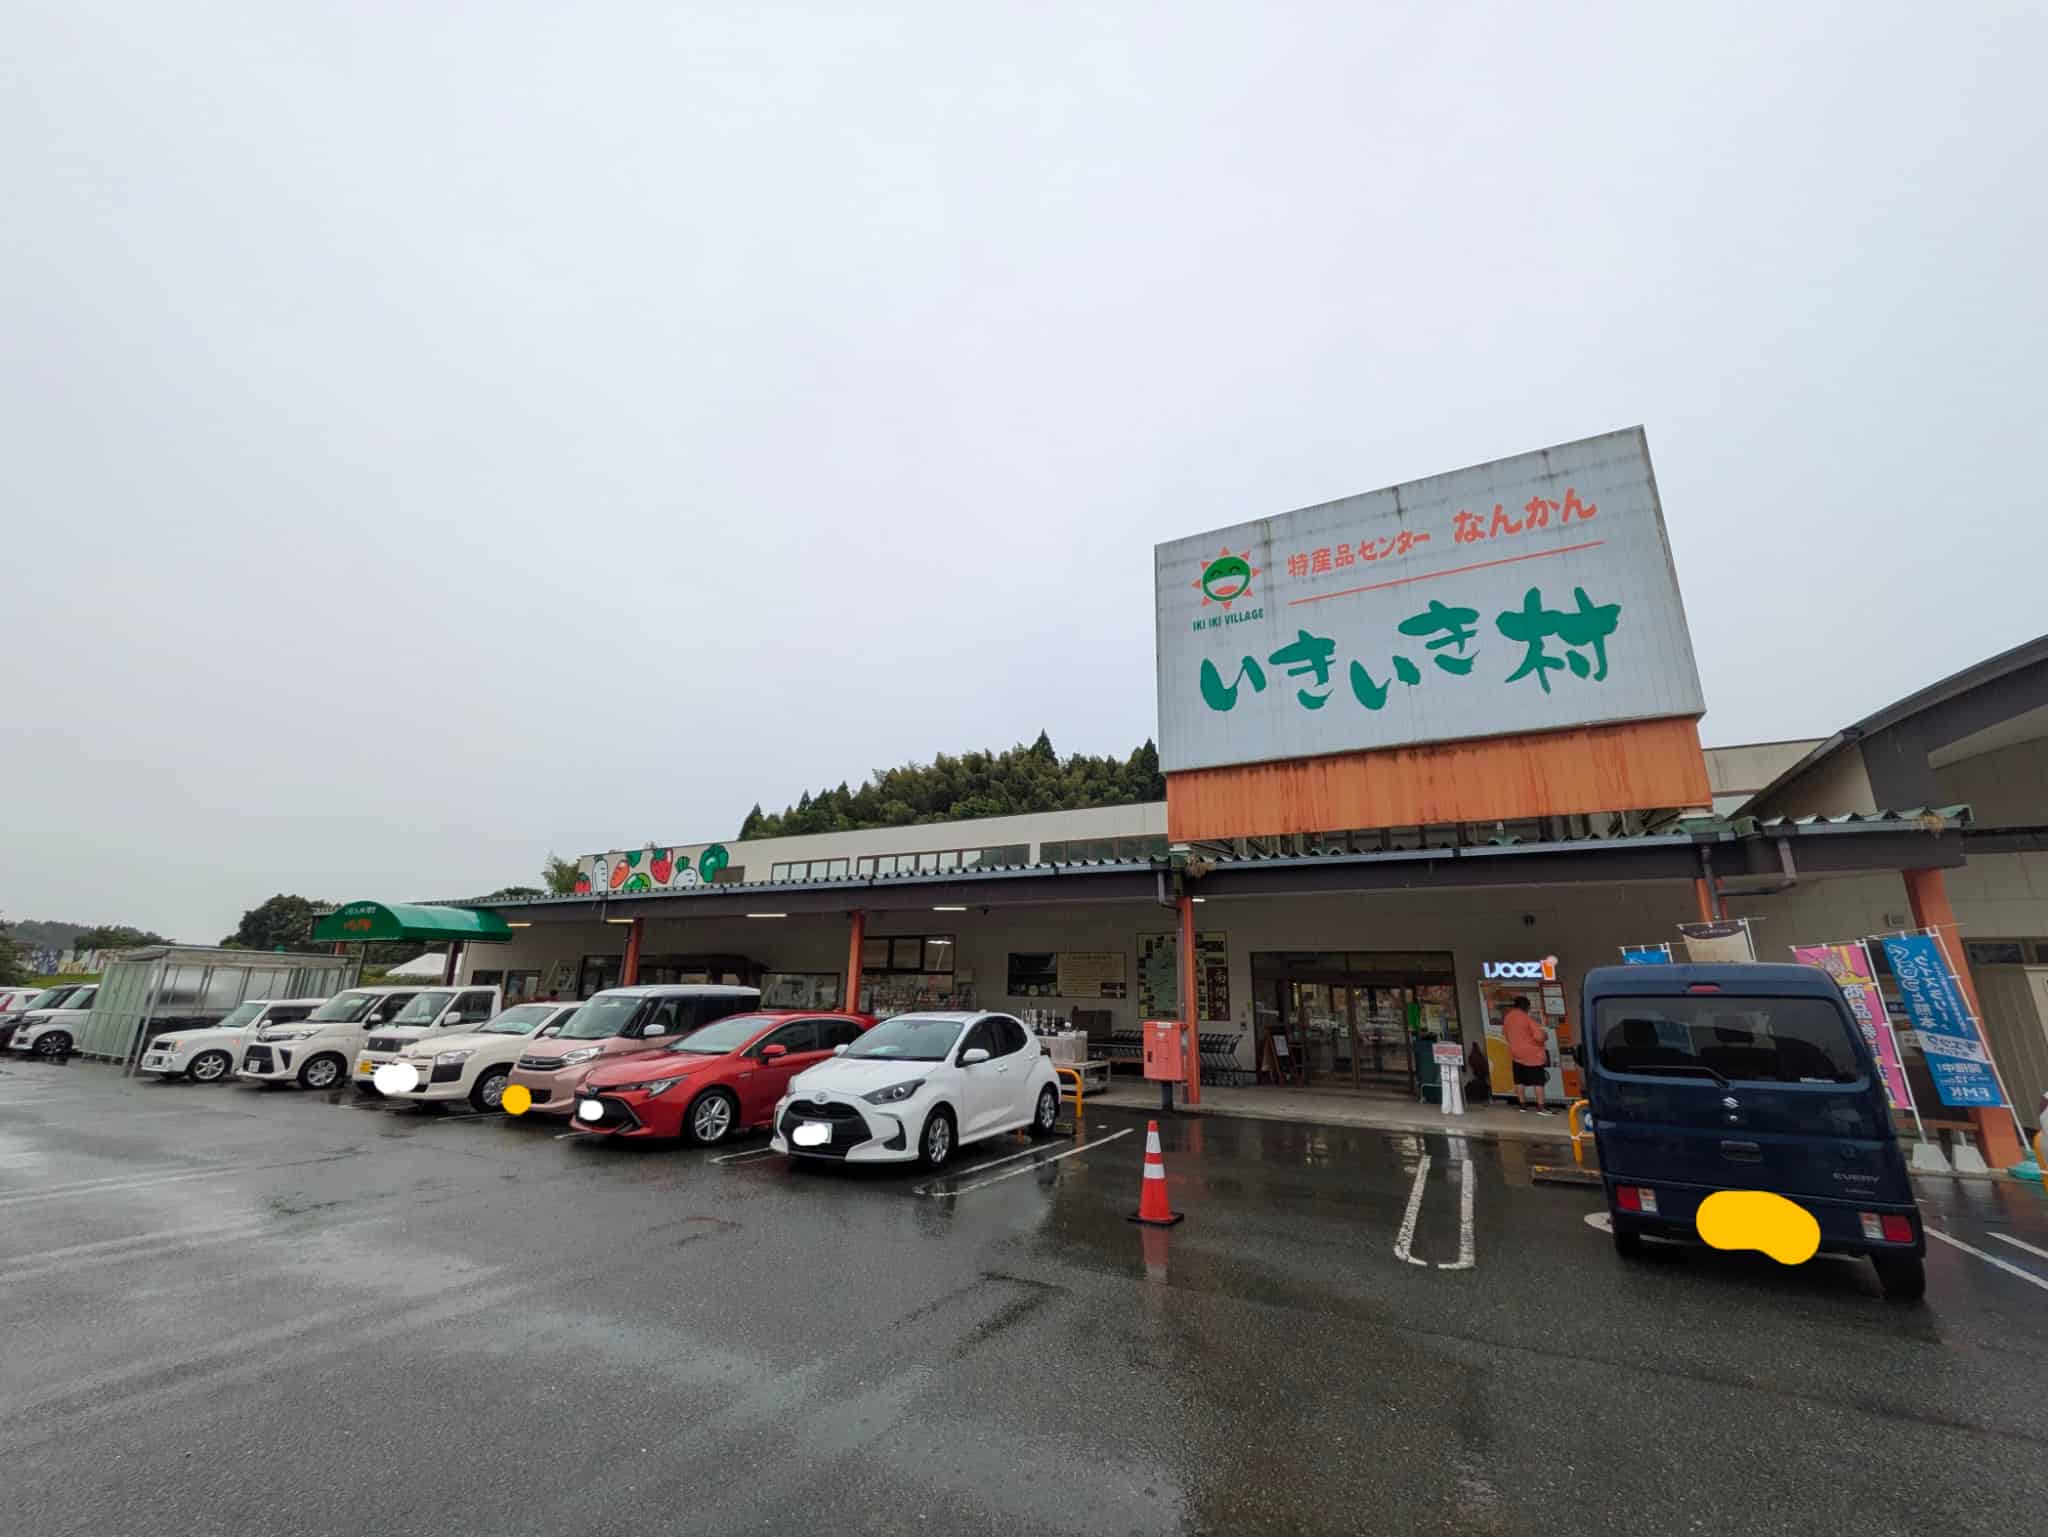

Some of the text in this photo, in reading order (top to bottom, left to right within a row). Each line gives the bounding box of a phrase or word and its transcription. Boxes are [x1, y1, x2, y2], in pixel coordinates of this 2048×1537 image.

[1288, 488, 1596, 578] 特産品センター なんかん
[1193, 608, 1264, 632] IKI IKI VILLAGE
[1200, 587, 1622, 712] いきいき村
